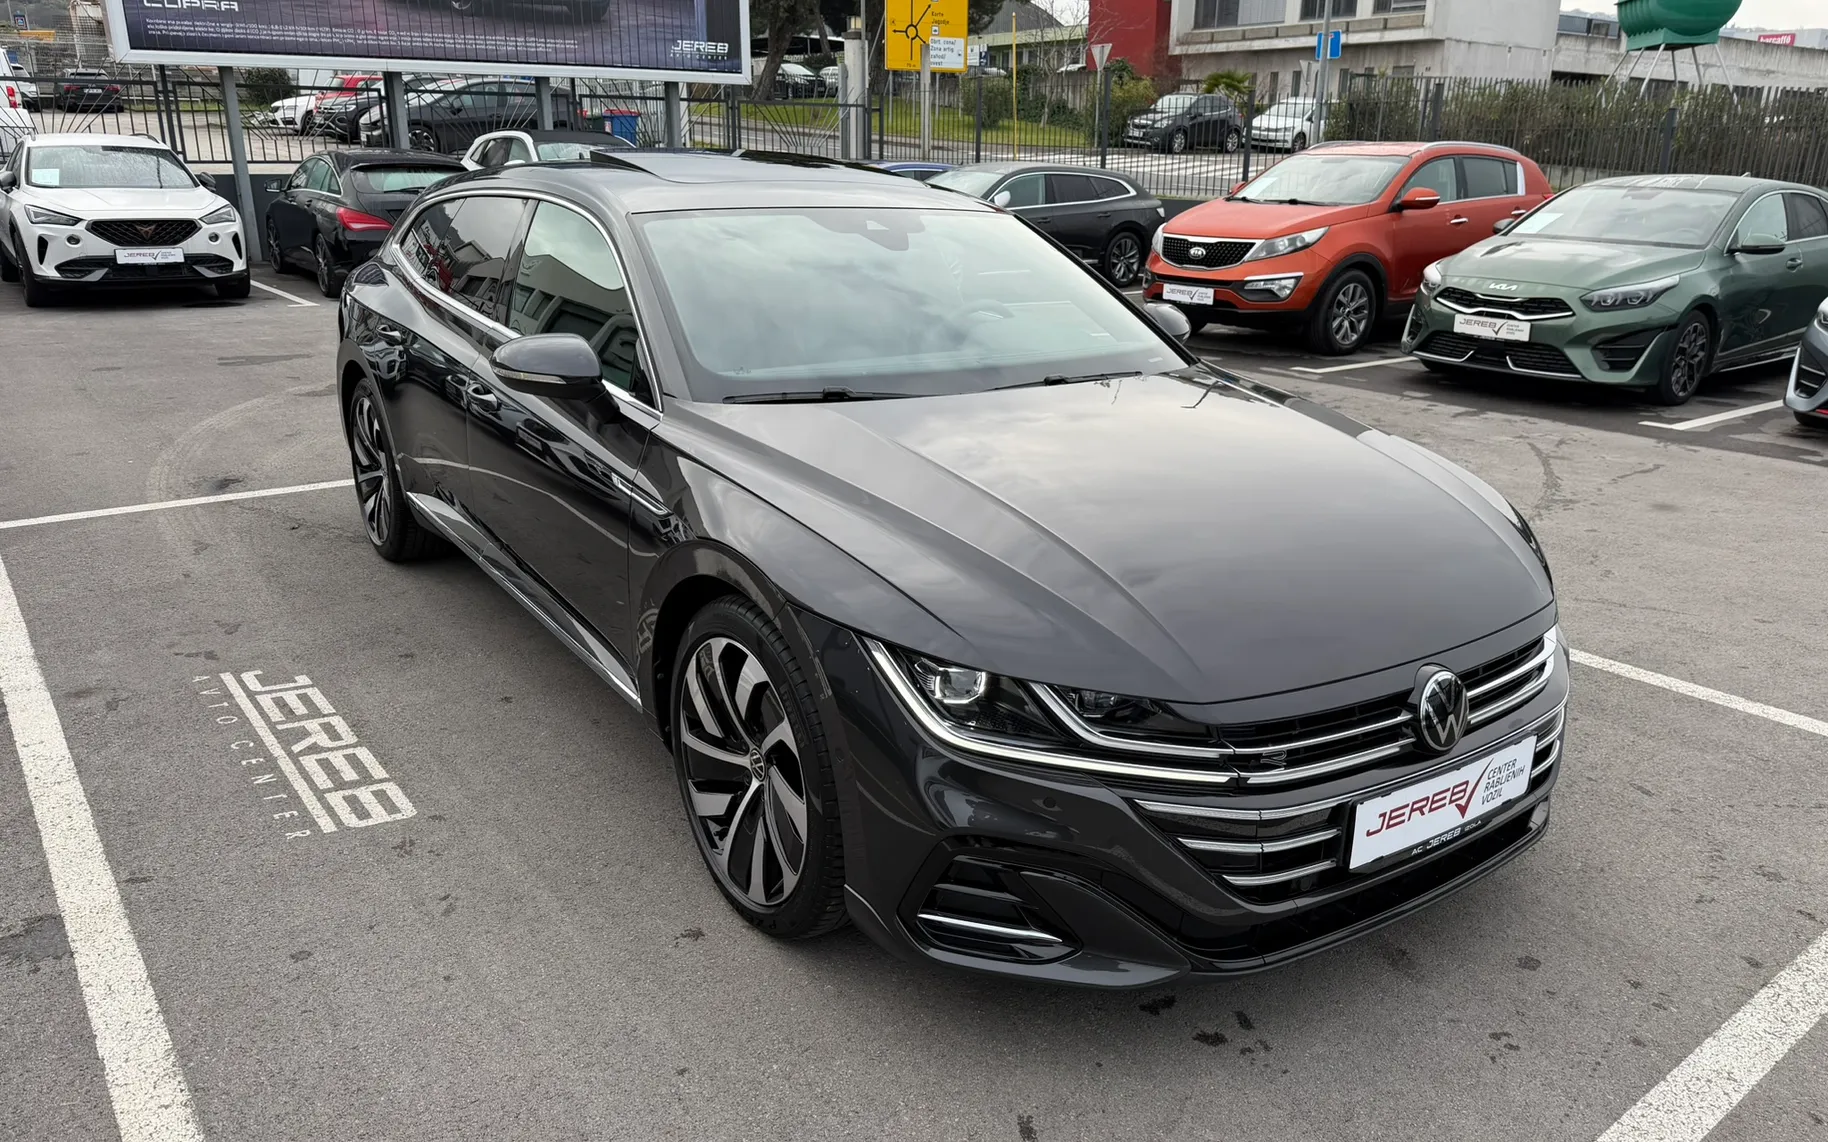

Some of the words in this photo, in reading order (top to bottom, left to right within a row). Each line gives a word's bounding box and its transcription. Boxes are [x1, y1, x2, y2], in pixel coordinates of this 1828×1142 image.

[671, 40, 729, 53] JEREB
[1459, 318, 1497, 328] JEREB
[192, 675, 238, 725] AVTO
[230, 740, 311, 840] CENTER
[240, 669, 418, 828] JEREB
[1483, 765, 1526, 794] RABLJENIH
[1487, 758, 1518, 779] CENTER
[1366, 779, 1470, 838] JEREB
[1481, 788, 1504, 806] VOZIL
[1411, 846, 1423, 856] AC
[1426, 827, 1462, 850] JEREB
[1464, 820, 1482, 832] IZOLA
